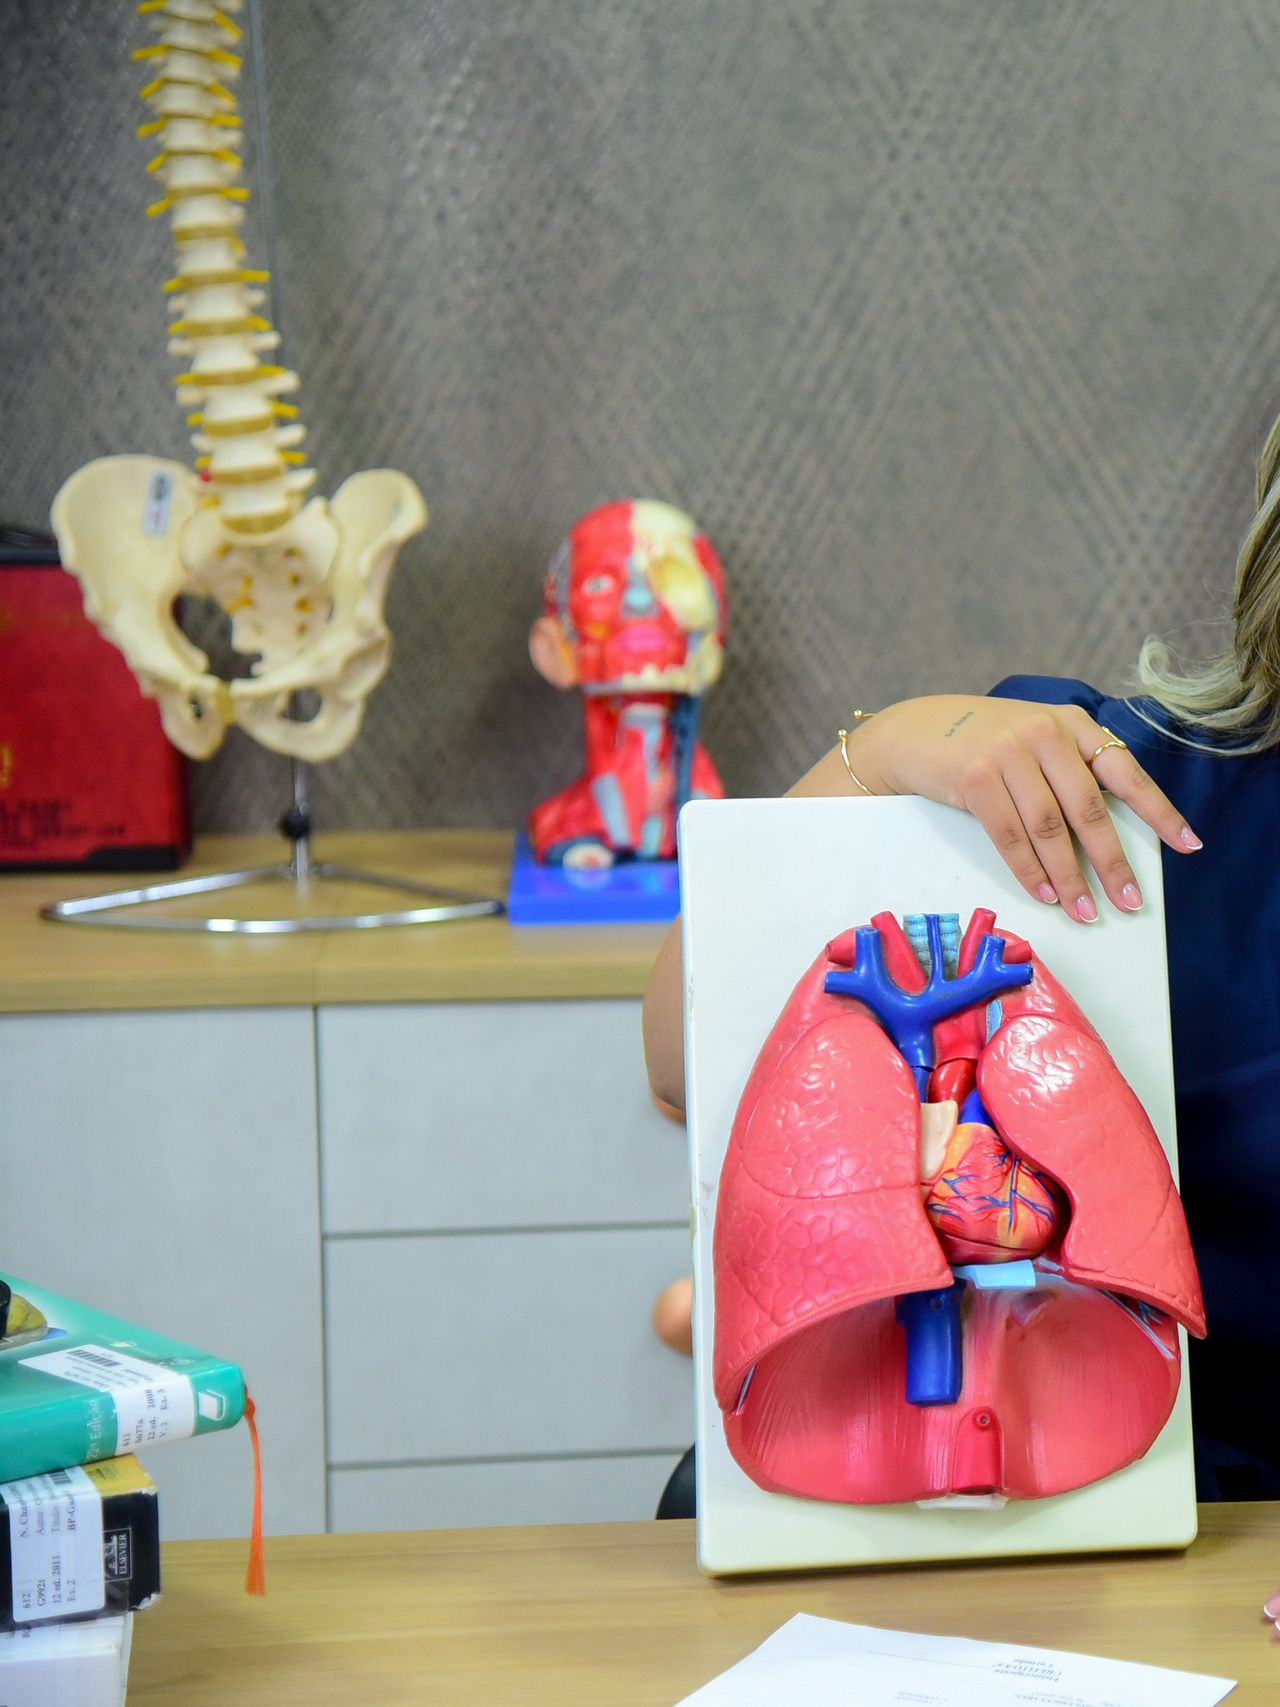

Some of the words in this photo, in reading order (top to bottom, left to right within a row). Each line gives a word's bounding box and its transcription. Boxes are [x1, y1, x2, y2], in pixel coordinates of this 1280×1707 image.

[144, 1388, 155, 1410] 2008
[118, 1533, 127, 1575] ELSEVIER
[52, 1554, 61, 1577] 2011
[22, 1592, 31, 1609] 612
